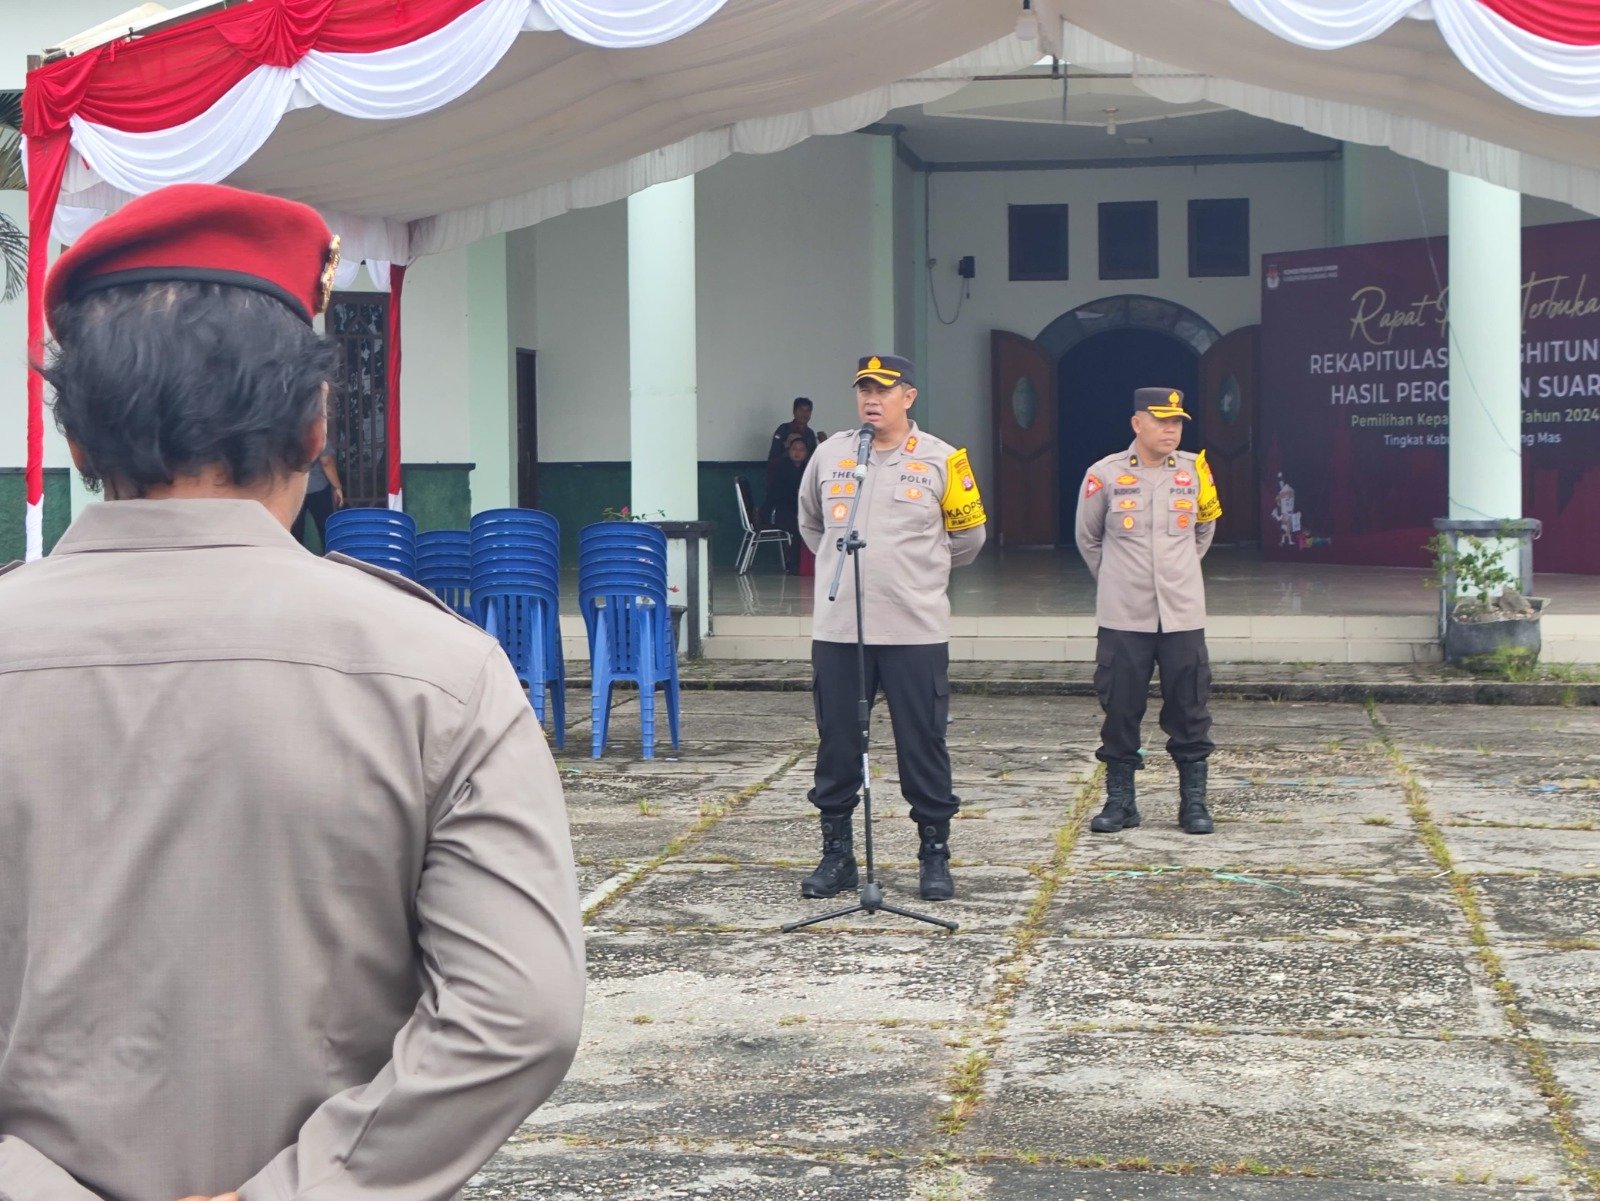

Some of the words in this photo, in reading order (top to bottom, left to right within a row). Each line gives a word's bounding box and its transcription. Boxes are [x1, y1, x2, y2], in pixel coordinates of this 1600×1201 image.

[1350, 286, 1437, 345] Rapat
[1521, 271, 1600, 333] Terbuka
[1310, 347, 1449, 374] REKAPITULAS
[1331, 383, 1390, 404] HASIL
[1538, 374, 1600, 398] SUAR
[1351, 412, 1413, 427] Pemilihan
[1417, 412, 1449, 428] Kepa
[1564, 407, 1600, 422] 2024
[1384, 433, 1424, 448] Tingkat
[1537, 432, 1561, 443] Mas
[900, 474, 932, 486] POLRI
[1169, 487, 1196, 496] POLRI
